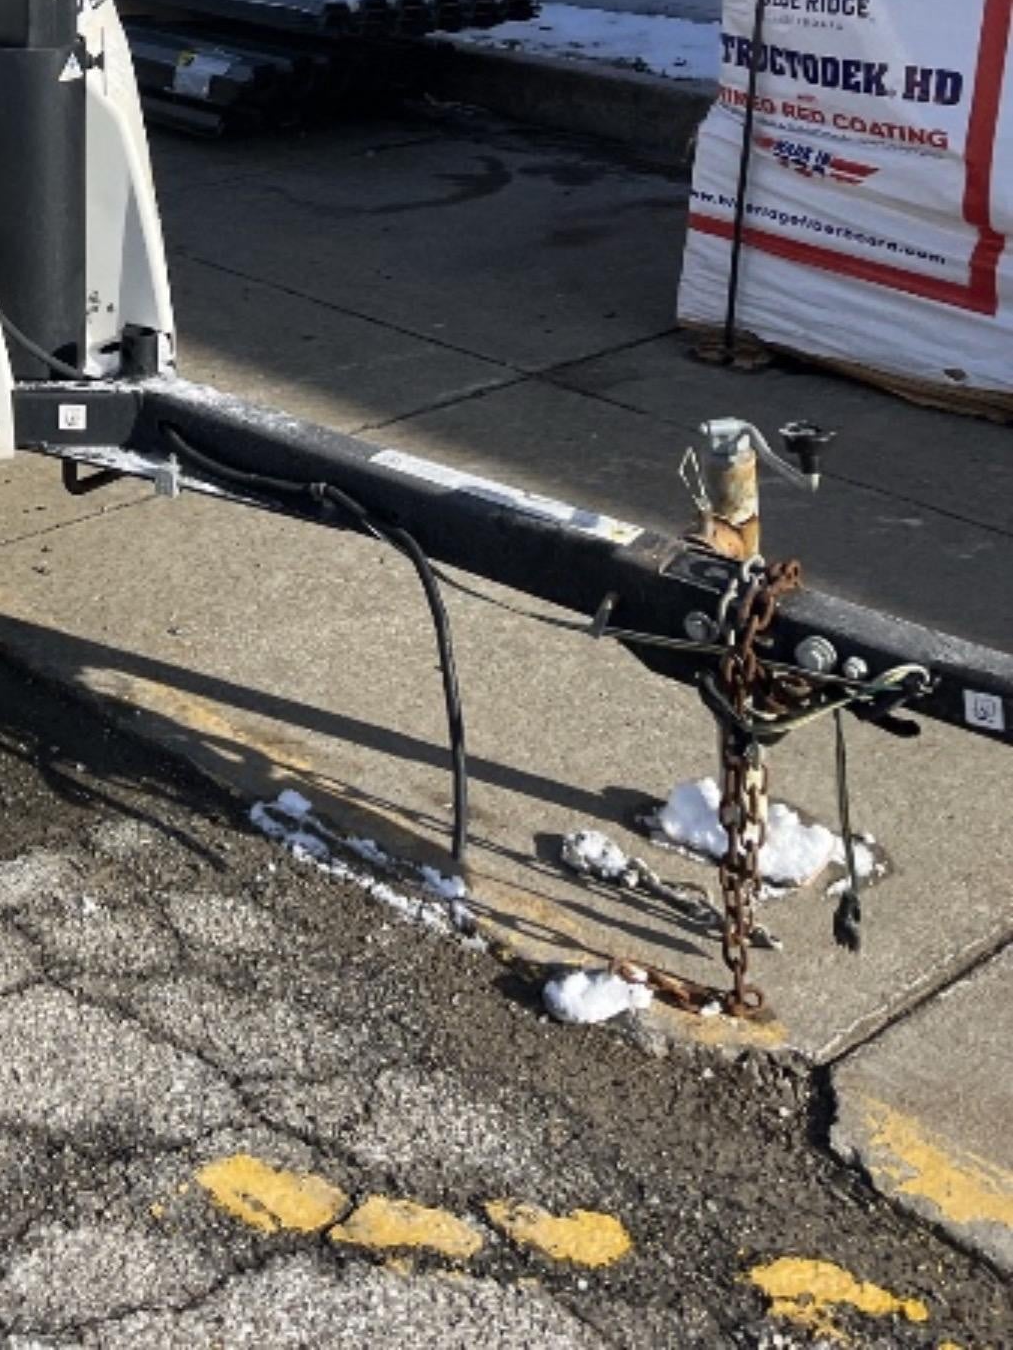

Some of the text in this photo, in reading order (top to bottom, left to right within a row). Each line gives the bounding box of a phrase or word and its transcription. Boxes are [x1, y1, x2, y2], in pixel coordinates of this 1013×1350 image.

[720, 32, 963, 105] TRUCTODEK HD
[782, 101, 825, 124] RED
[832, 113, 948, 149] COATING
